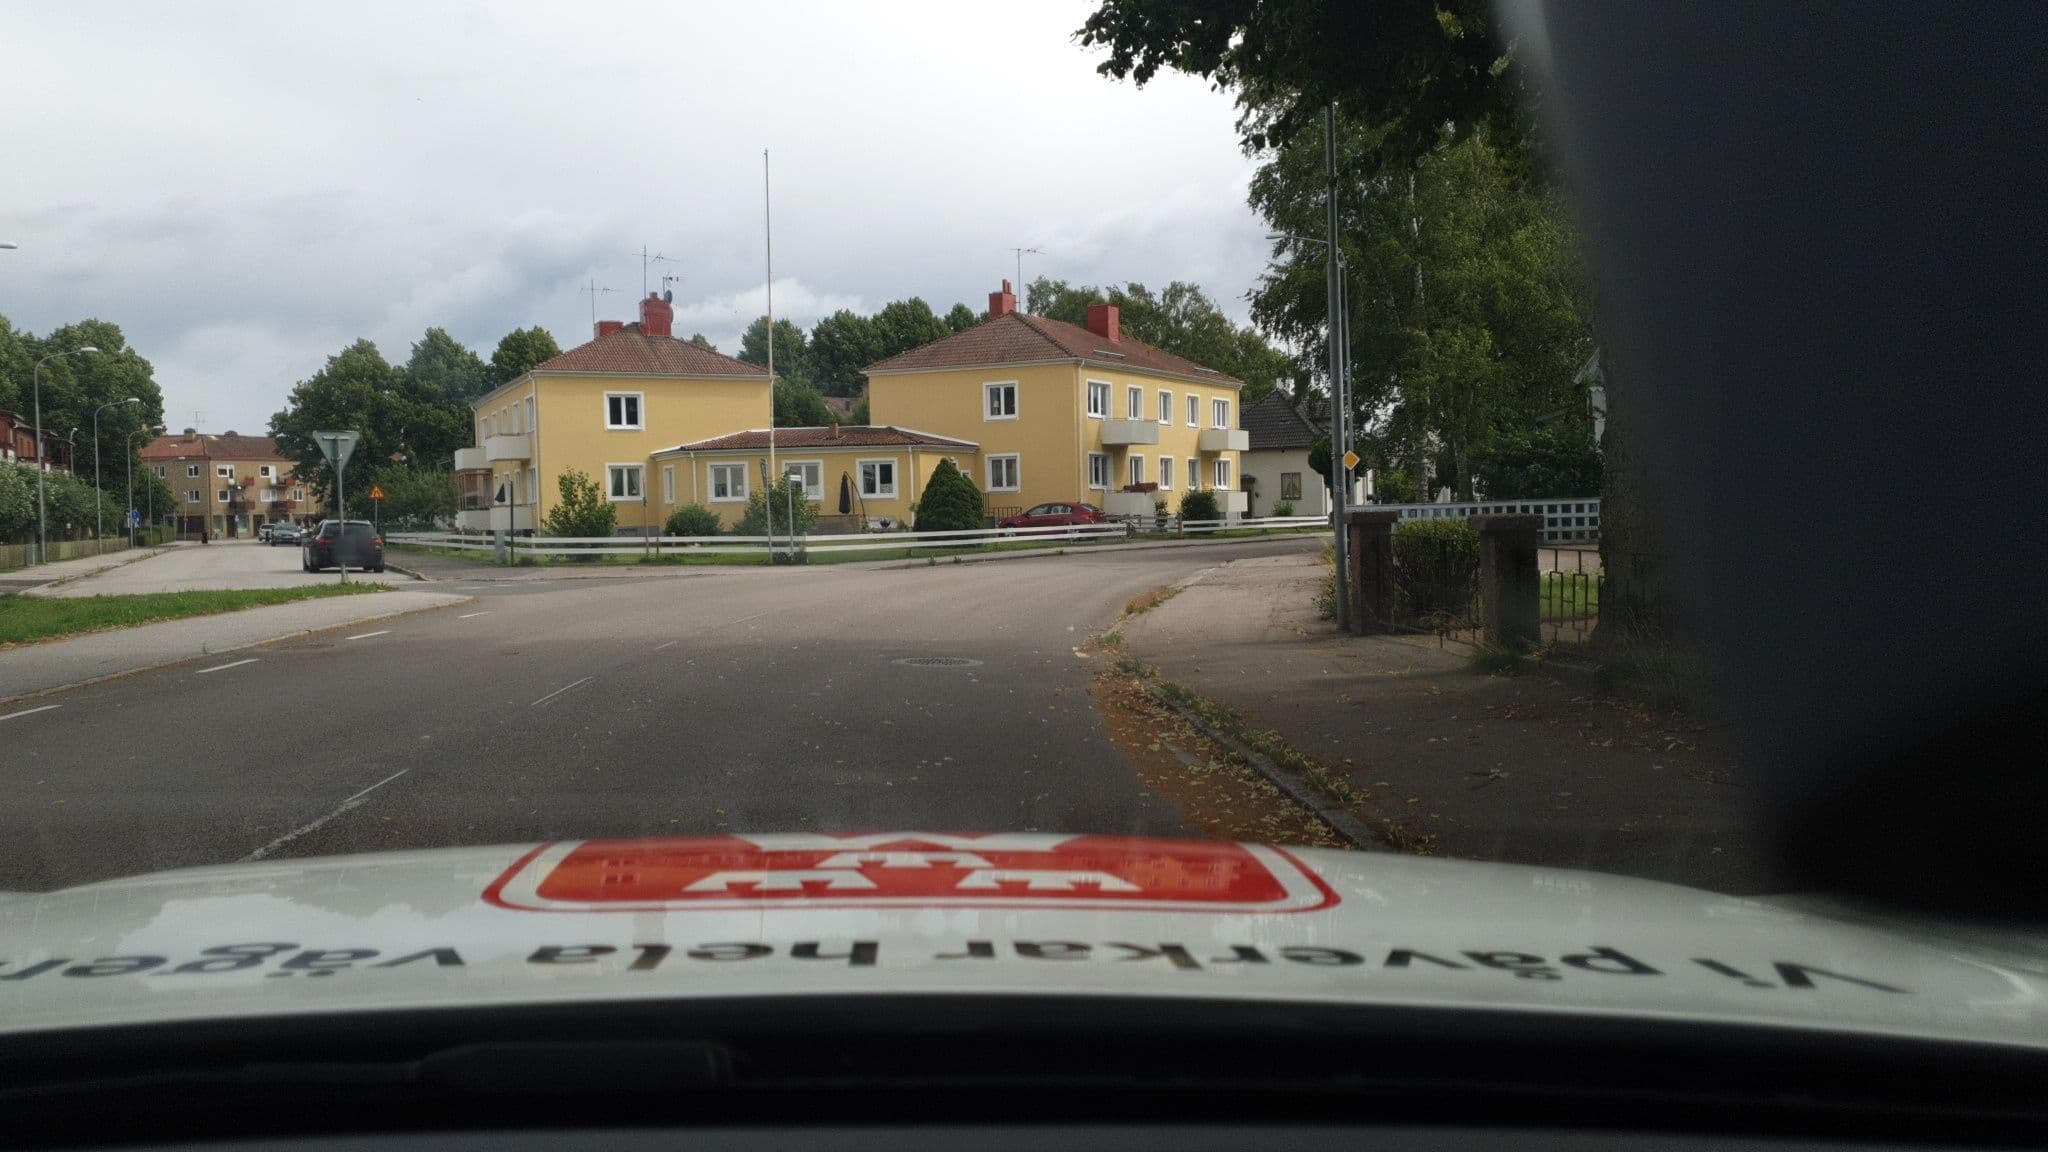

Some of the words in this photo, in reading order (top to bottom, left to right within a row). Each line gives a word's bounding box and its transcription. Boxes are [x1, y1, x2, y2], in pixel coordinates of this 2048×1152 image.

[527, 940, 879, 971] hela
[935, 940, 1665, 981] påverkar
[1692, 957, 1912, 994] Vi
